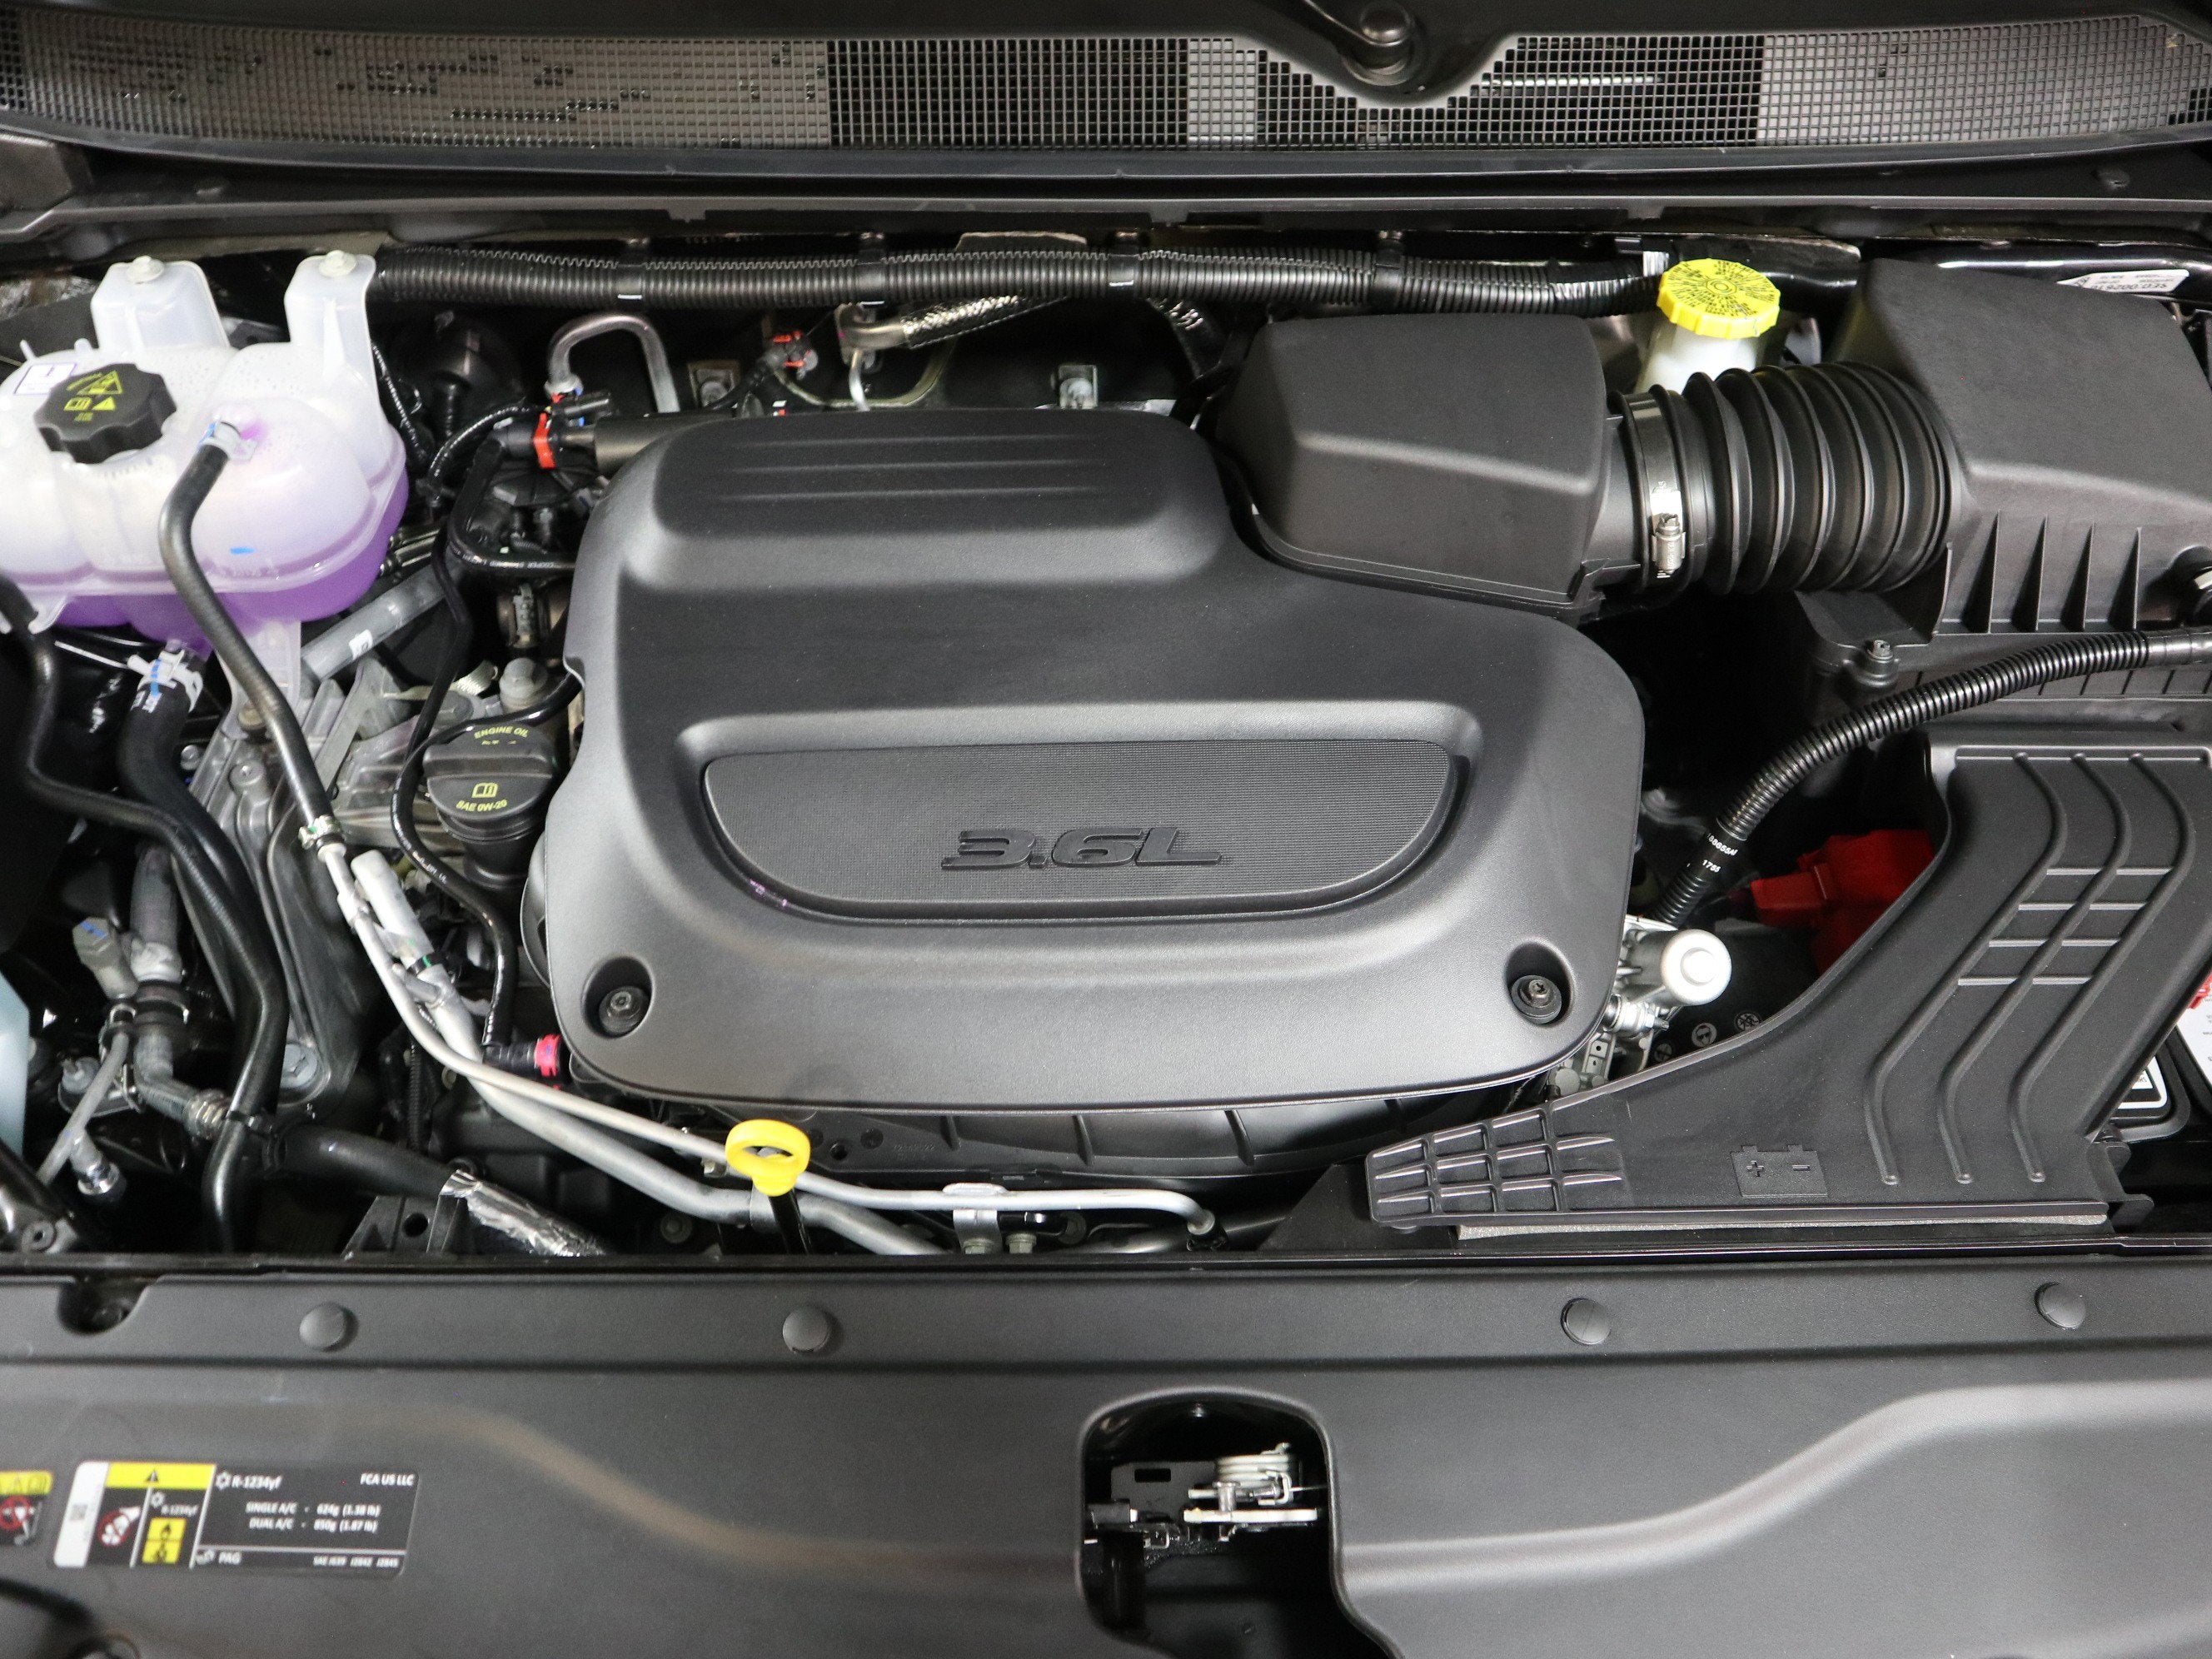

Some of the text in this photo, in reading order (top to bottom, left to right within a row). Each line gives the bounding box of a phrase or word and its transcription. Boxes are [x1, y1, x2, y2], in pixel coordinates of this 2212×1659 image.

[474, 726, 529, 740] ENGINE OIL
[456, 799, 508, 812] SAE 0W-20
[941, 826, 1223, 870] 3.6L
[360, 1472, 416, 1487] FCA US LLC
[278, 1502, 298, 1515] A/C
[275, 1517, 294, 1531] A/C
